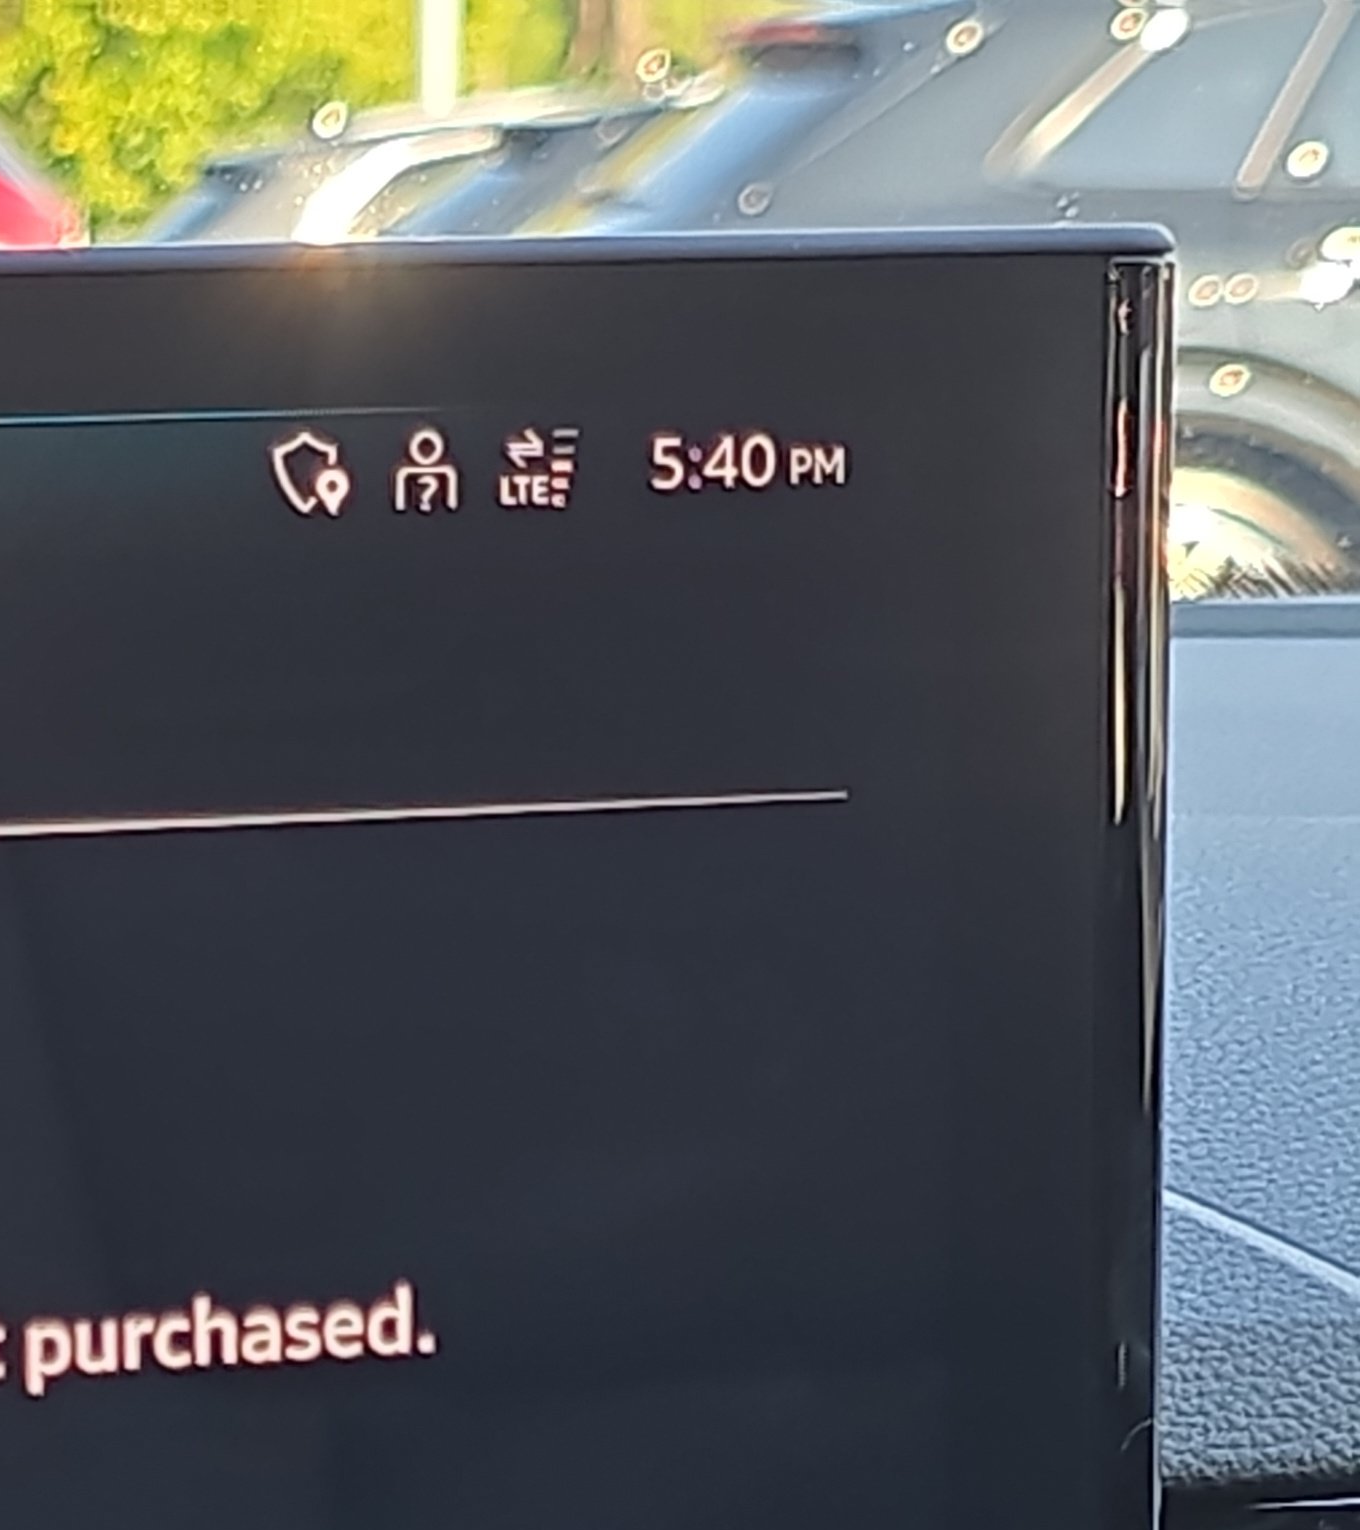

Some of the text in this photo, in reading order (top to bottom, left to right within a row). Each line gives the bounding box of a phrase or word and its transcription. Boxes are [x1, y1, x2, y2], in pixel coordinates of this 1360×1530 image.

[498, 475, 550, 506] LTE
[649, 432, 846, 491] 5:40 PM
[23, 1280, 437, 1397] purchased.
